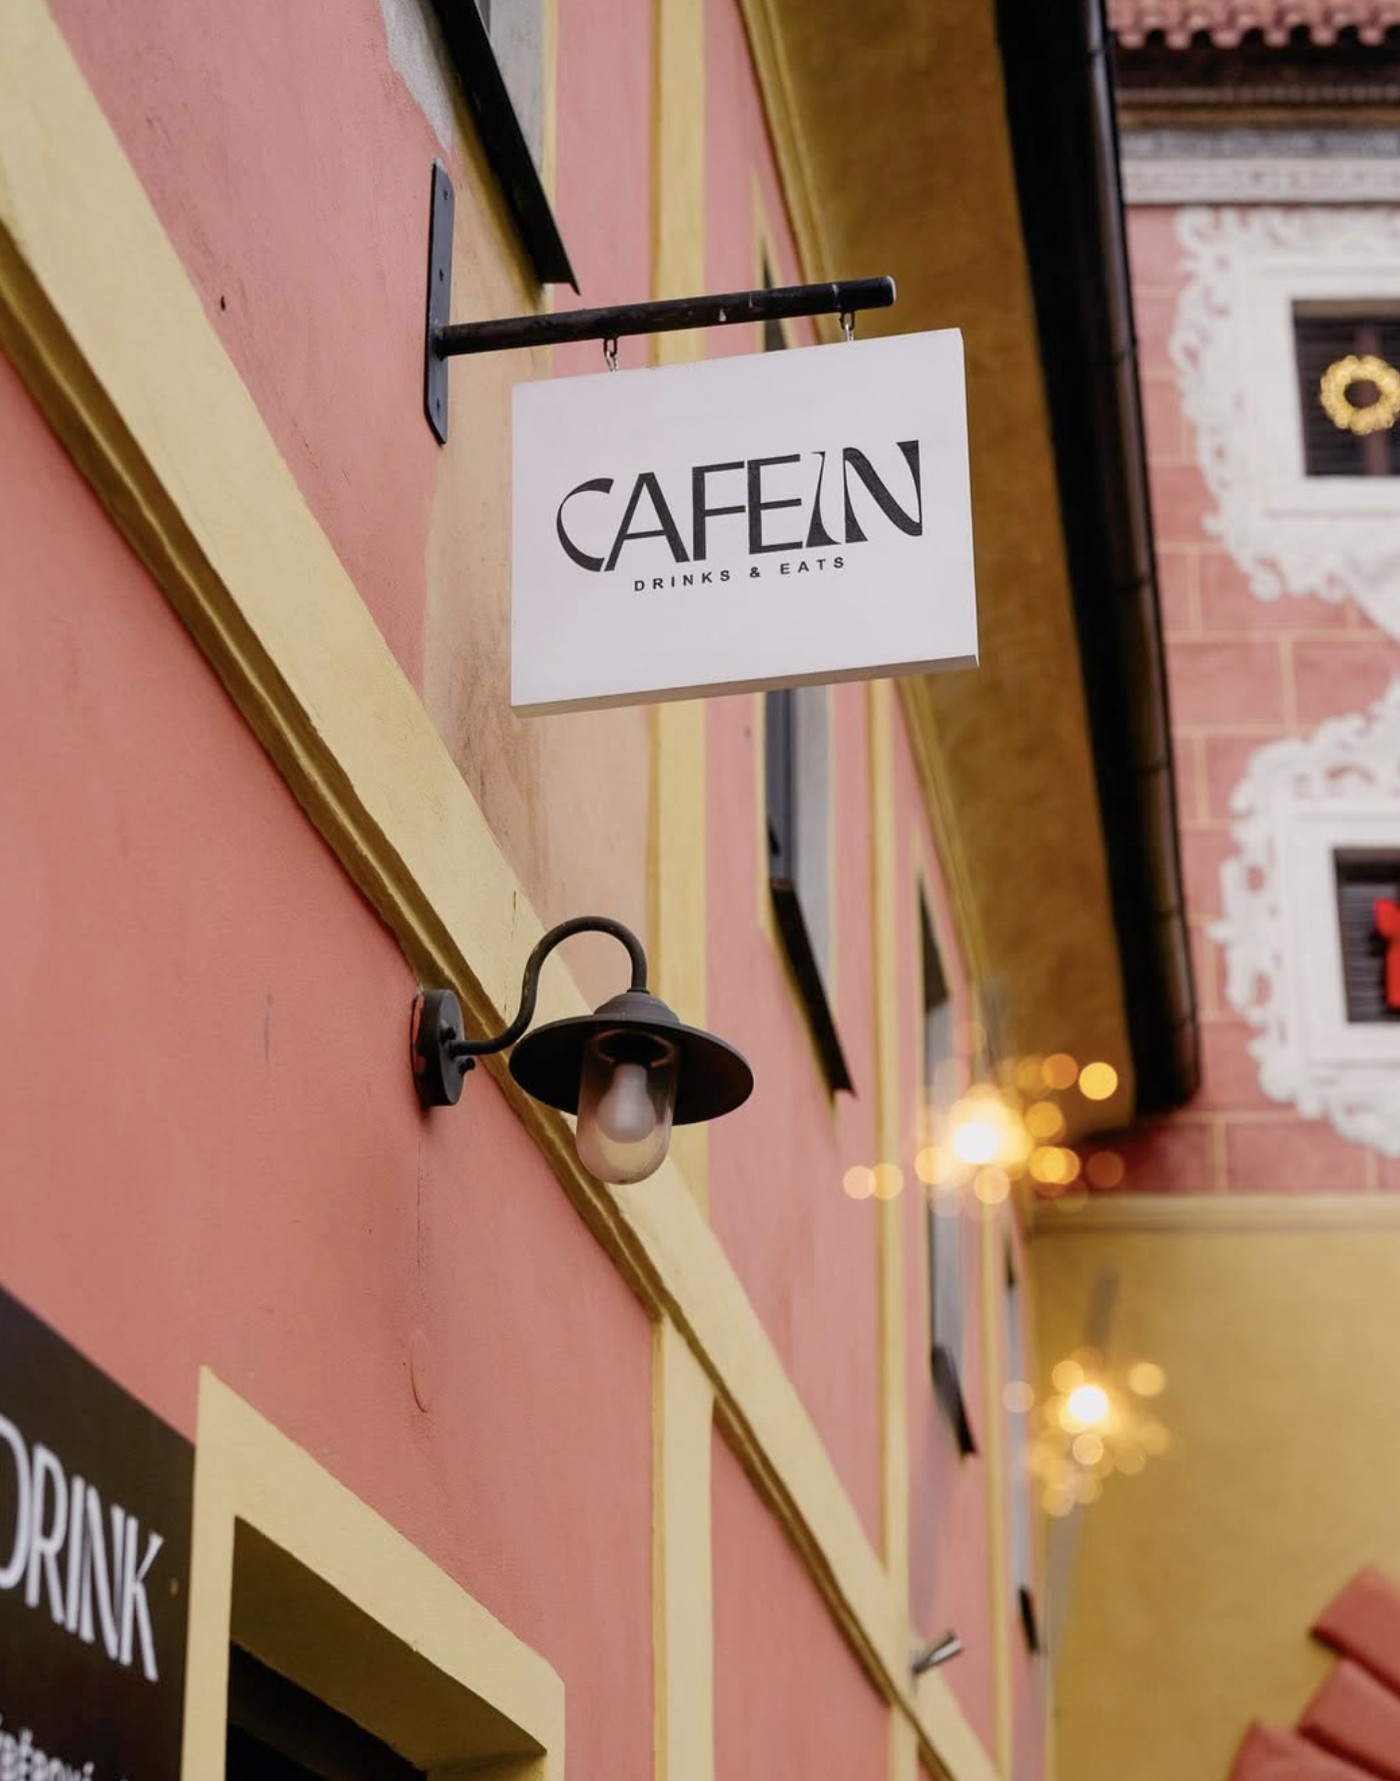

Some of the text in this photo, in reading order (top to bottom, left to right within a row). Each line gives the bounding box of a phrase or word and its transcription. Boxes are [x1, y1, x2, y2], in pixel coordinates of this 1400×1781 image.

[556, 439, 923, 573] CAFEIN
[634, 556, 845, 592] DRINKS & EATS
